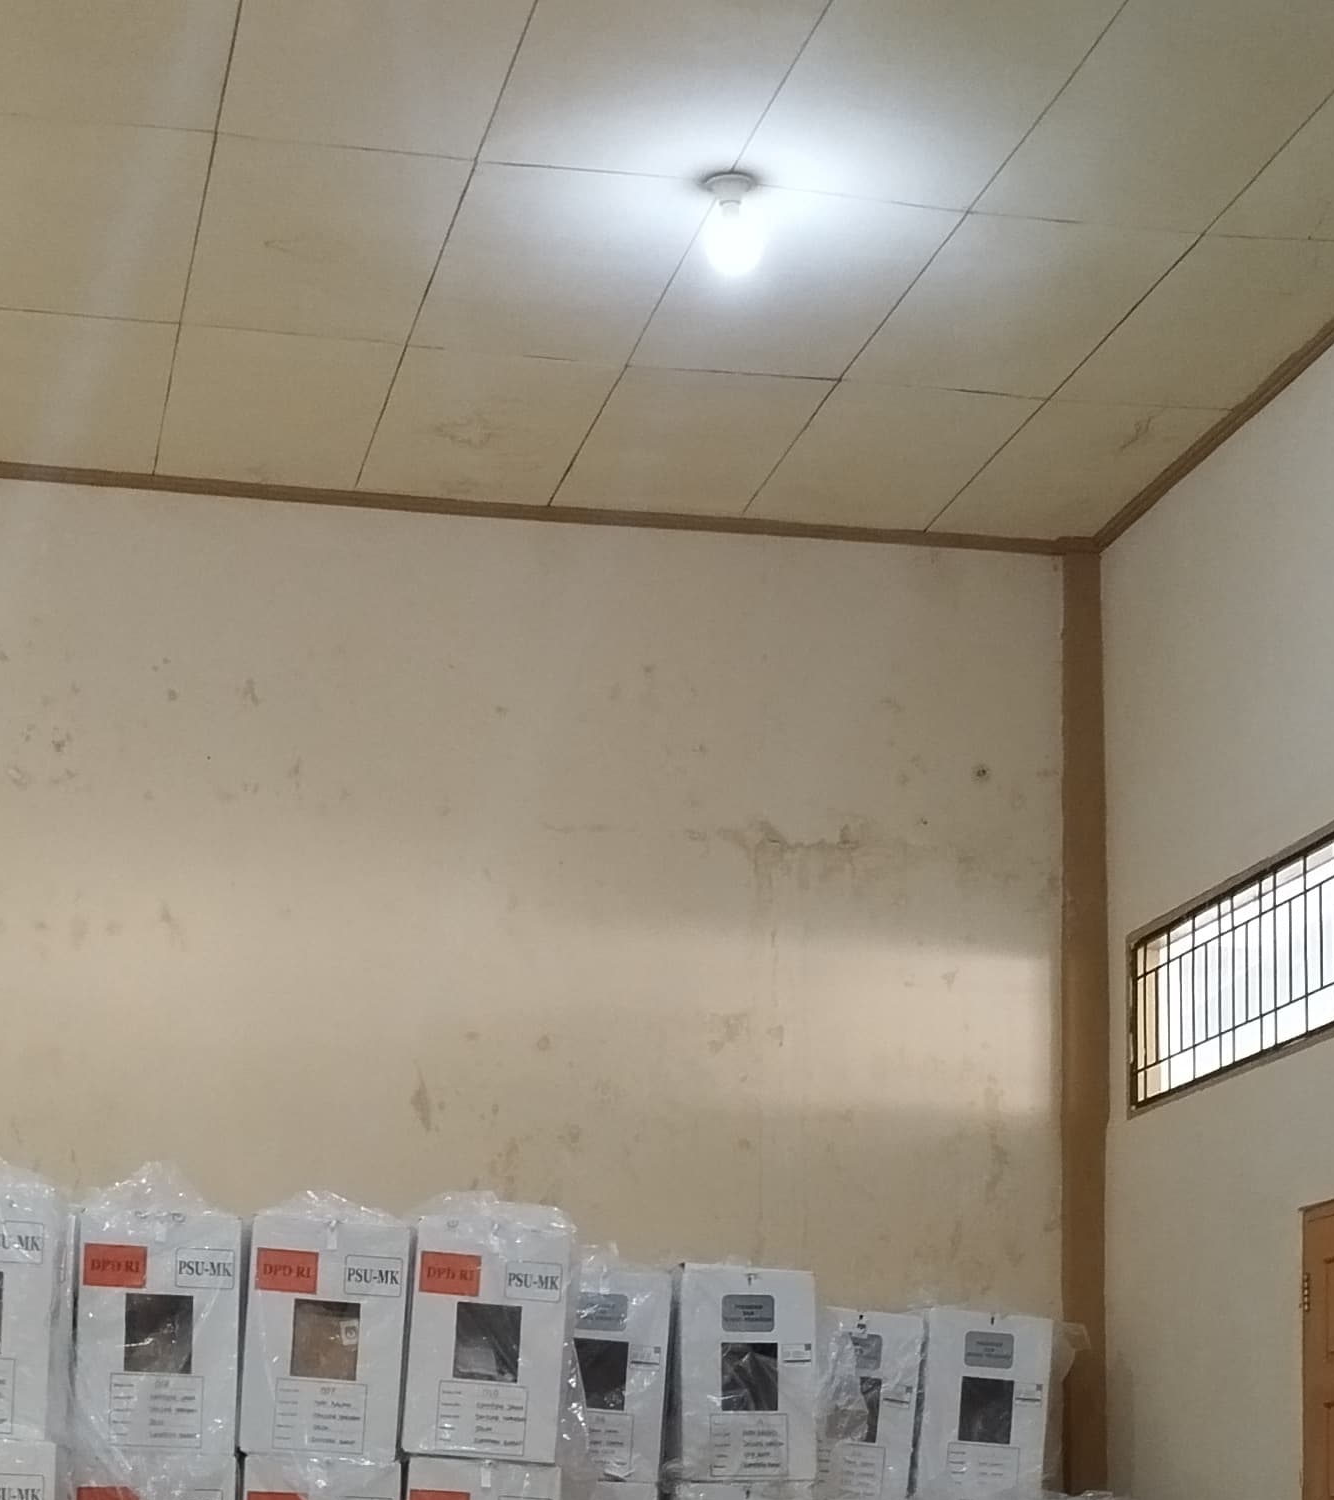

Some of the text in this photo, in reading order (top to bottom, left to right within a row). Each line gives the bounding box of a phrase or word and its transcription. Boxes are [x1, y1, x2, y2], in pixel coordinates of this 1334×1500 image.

[126, 1259, 140, 1274] RI
[178, 1260, 232, 1277] PSU-MK
[262, 1263, 311, 1279] DPD RI
[460, 1267, 474, 1282] RI
[347, 1267, 400, 1285] PSU-MK
[508, 1272, 559, 1290] PSU-MK
